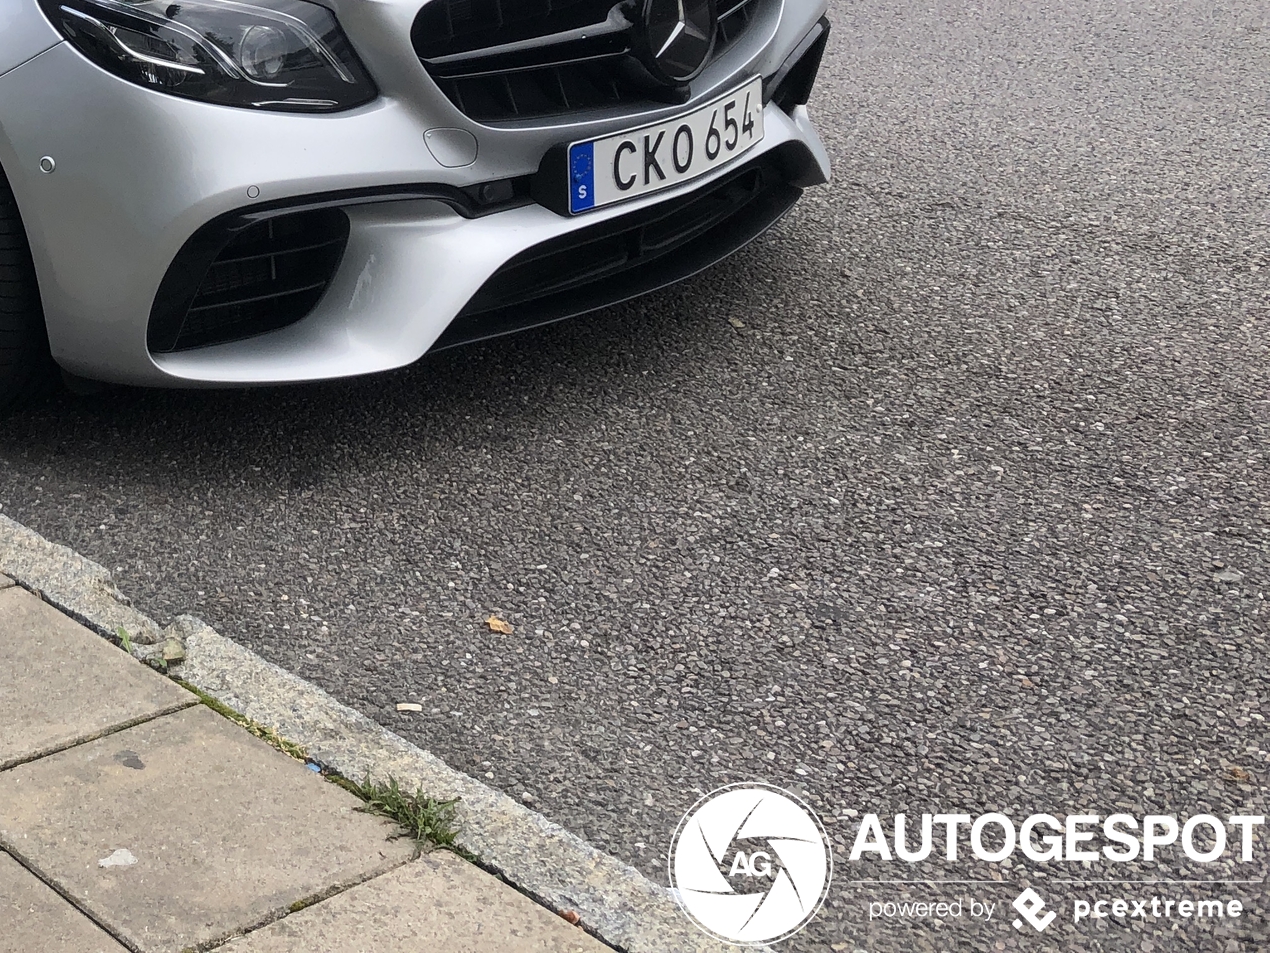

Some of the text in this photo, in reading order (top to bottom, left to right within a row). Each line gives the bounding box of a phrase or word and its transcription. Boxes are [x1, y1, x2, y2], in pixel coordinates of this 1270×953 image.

[612, 91, 755, 191] CKO 654
[577, 184, 588, 199] S
